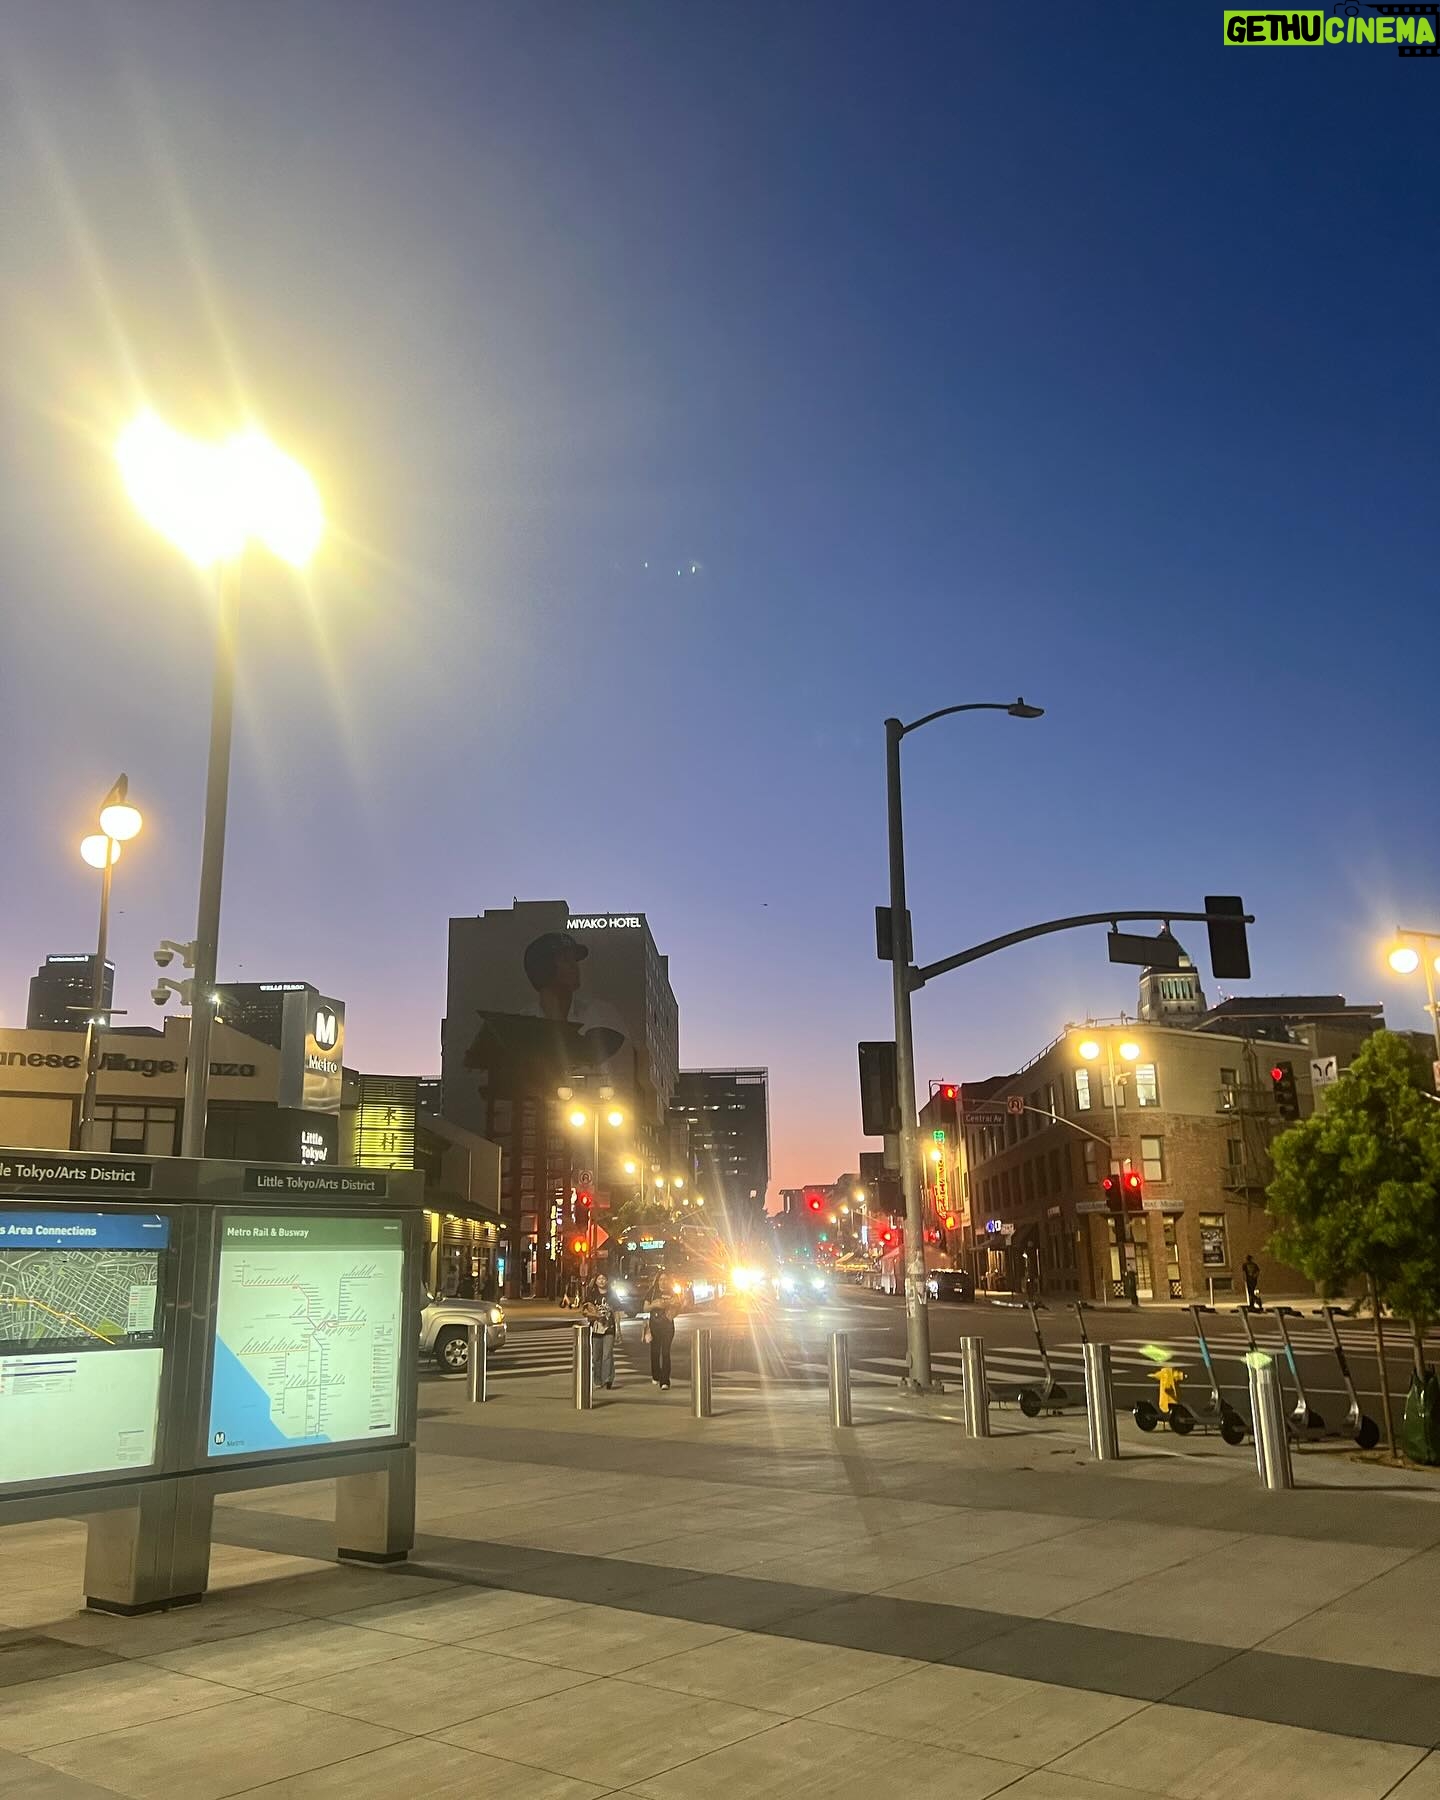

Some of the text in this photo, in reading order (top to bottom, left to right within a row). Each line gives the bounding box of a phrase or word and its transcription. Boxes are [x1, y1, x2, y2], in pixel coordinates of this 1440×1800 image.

[566, 917, 641, 929] MIYAKO HOTEL
[316, 1012, 336, 1045] M
[308, 1054, 338, 1074] Metro
[380, 1082, 399, 1169] 日本村
[965, 1113, 992, 1122] Central
[302, 1130, 324, 1146] Little
[301, 1145, 328, 1161] Tokyo/
[15, 1164, 87, 1181] Tokyo/Arts
[91, 1168, 136, 1182] District
[257, 1175, 376, 1191] Little Tokyo/Arts District
[7, 1224, 33, 1235] Area
[35, 1225, 97, 1236] Connections
[227, 1227, 310, 1239] Metro Rail & Busway
